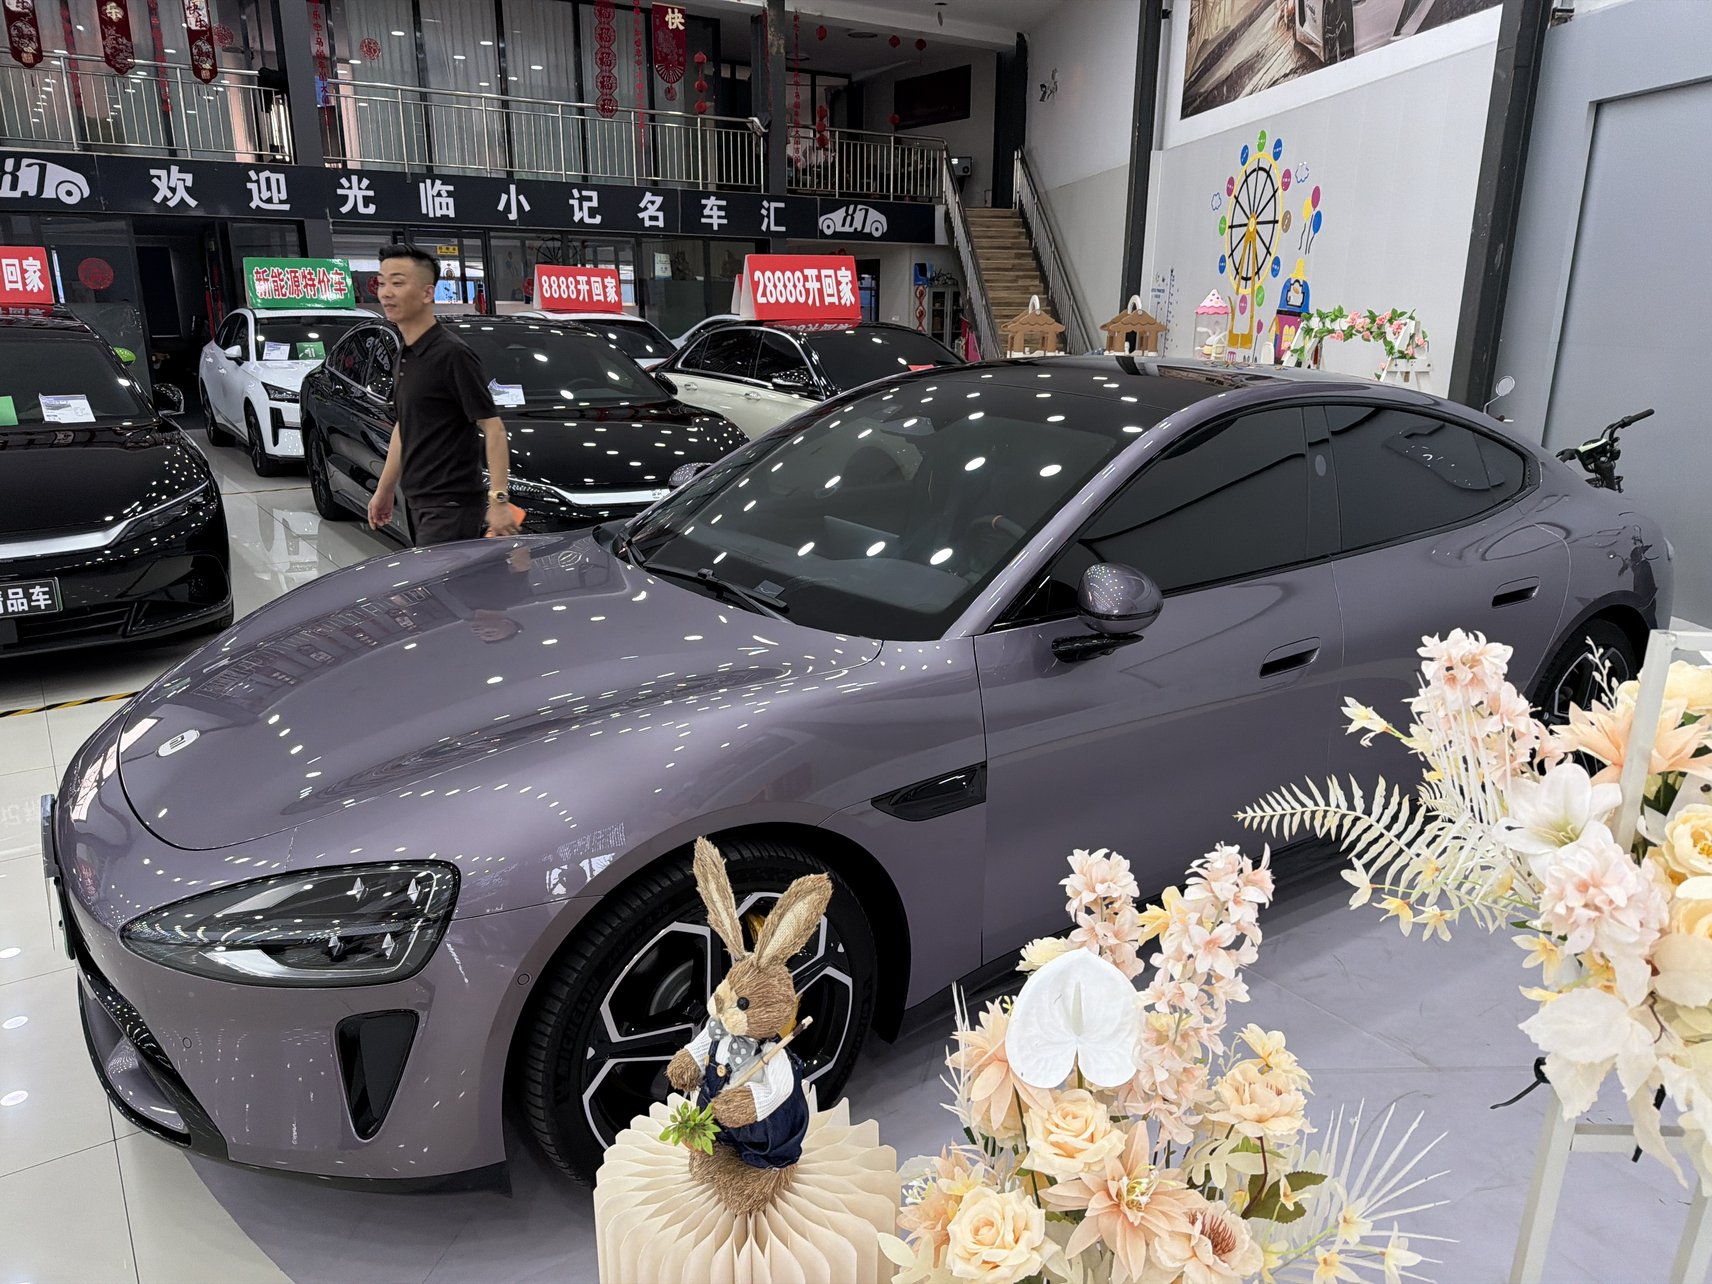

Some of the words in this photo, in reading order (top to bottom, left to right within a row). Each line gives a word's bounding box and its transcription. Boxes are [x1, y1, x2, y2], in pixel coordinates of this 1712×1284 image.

[665, 8, 685, 31] 快
[1, 256, 45, 293] 回家
[254, 267, 347, 298] 新能源特价车
[541, 275, 619, 304] 8888开回家
[754, 266, 855, 307] 28888开回家
[555, 976, 602, 1076] MICHELIN
